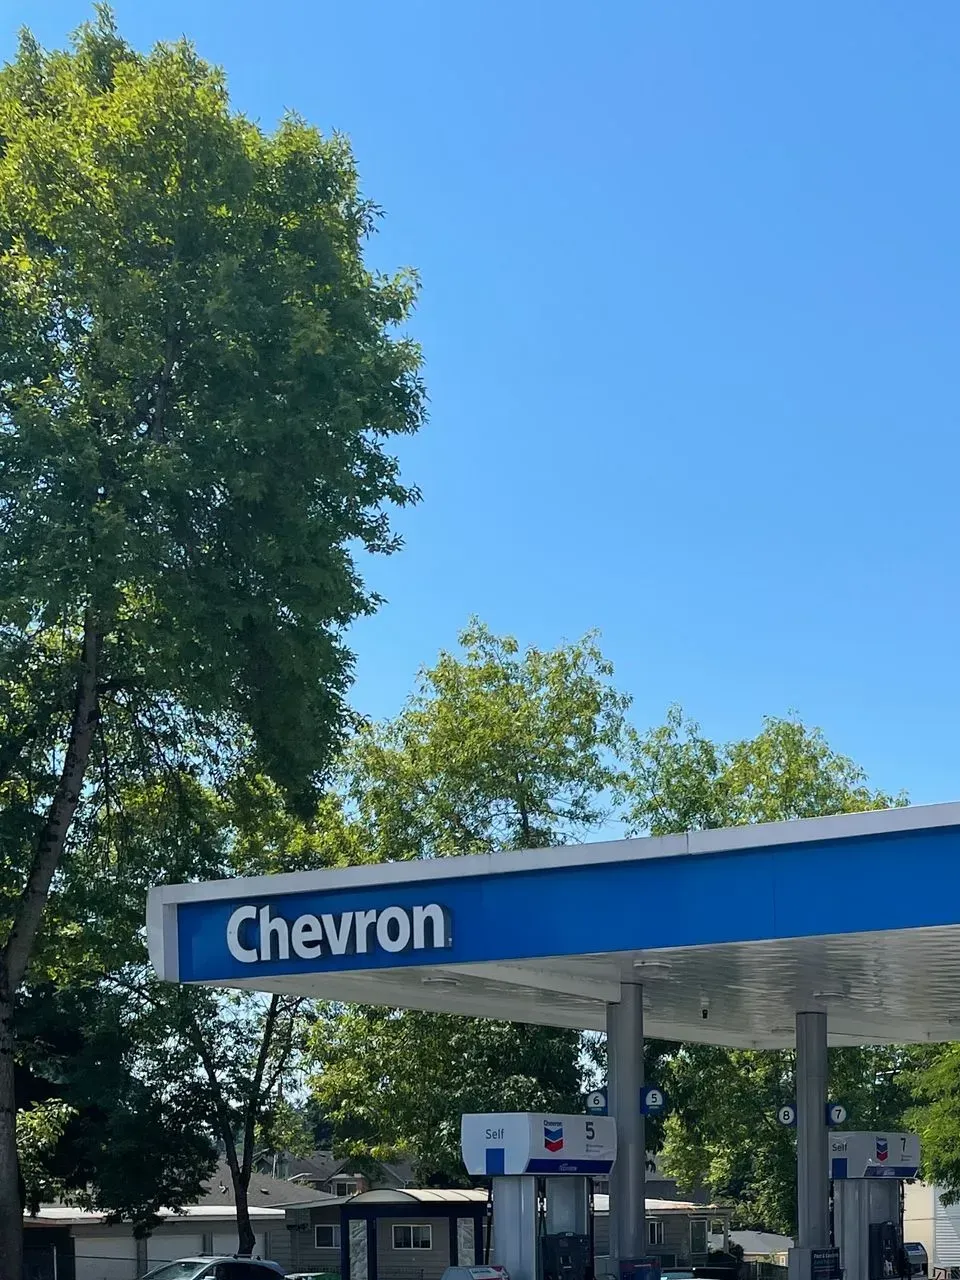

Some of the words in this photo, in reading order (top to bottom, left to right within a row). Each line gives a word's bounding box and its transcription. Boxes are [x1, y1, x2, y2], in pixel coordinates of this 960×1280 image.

[226, 903, 446, 963] Chevron
[593, 1093, 600, 1105] 6
[651, 1093, 658, 1103] 5
[783, 1110, 790, 1120] 8
[835, 1109, 842, 1119] 7
[485, 1128, 505, 1140] Self
[585, 1121, 595, 1140] 5
[832, 1142, 848, 1152] Self
[900, 1137, 907, 1152] 7
